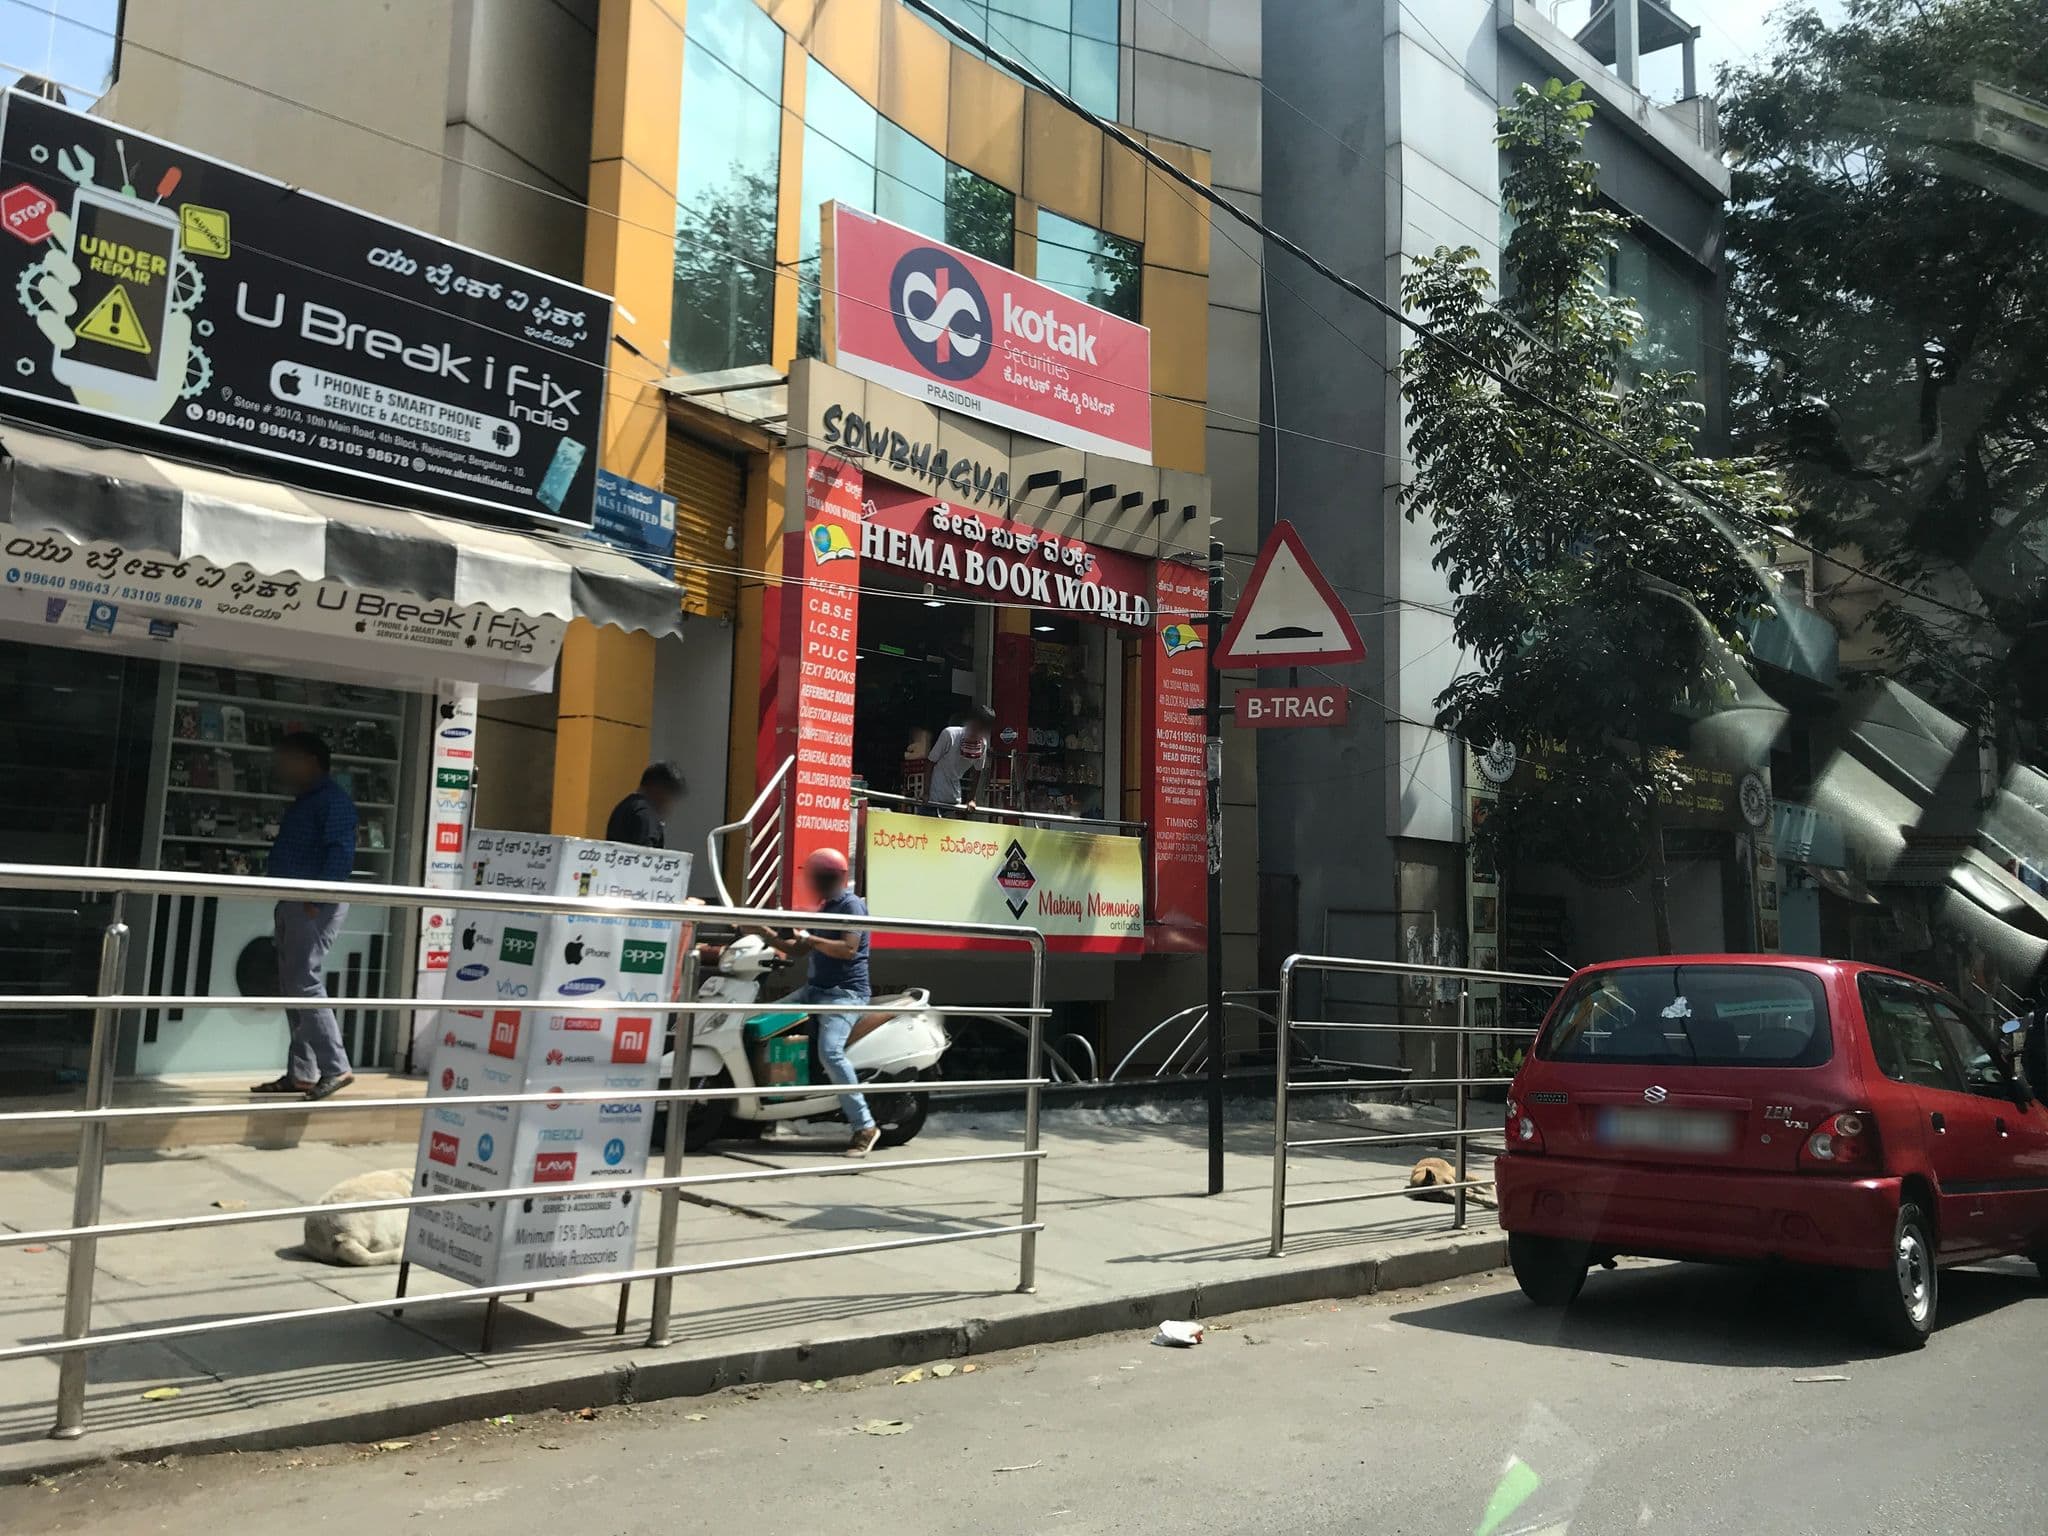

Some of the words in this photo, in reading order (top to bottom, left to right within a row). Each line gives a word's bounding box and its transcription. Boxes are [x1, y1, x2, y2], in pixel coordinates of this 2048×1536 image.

[9, 200, 47, 227] STOP
[79, 234, 167, 276] UNDER
[90, 257, 151, 285] REPAIR
[236, 281, 286, 328] U
[301, 301, 472, 384] Break
[484, 356, 495, 390] i
[1003, 293, 1098, 366] kotak
[1003, 340, 1070, 380] Securities
[234, 395, 262, 413] Store
[263, 404, 271, 413] #
[323, 375, 371, 400] PHONE
[375, 390, 385, 403] &
[388, 393, 435, 417] SMART
[439, 407, 482, 430] PHONE
[927, 384, 981, 412] PRASIDDHI
[324, 394, 375, 418] SERVICE
[379, 406, 388, 420] &
[391, 411, 472, 443] ACCESSORIES
[509, 400, 570, 431] India
[206, 409, 256, 431] 99640
[259, 421, 306, 443] 99643
[319, 436, 363, 456] 83105
[366, 447, 409, 467] 98678
[823, 404, 1009, 511] SOWBHAGYA
[427, 463, 534, 496] www.ubreakifixindia.com
[861, 521, 959, 582] HEMA
[965, 549, 1051, 605] BOOK
[1054, 574, 1152, 629] WORLD
[23, 571, 65, 588] 99640
[69, 577, 110, 595] 99643
[121, 586, 161, 603] 83105
[164, 594, 203, 609] 98678
[317, 587, 348, 610] U
[355, 593, 466, 630] Break
[473, 612, 482, 632] i
[809, 599, 853, 621] C.B.S.E
[809, 620, 851, 641] I.C.S.E
[808, 641, 849, 662] P.U.C
[801, 661, 824, 678] TEXT
[824, 666, 855, 685] BOOKS
[1172, 667, 1194, 677] ADDRESS
[800, 705, 832, 721] QUESTION
[832, 711, 853, 726] BANKS
[1247, 696, 1335, 719] B-TRAC
[799, 749, 829, 765] GENERAL
[829, 753, 852, 768] BOOKS
[1163, 752, 1179, 762] HEAD
[1180, 754, 1201, 764] OFFICE
[798, 770, 829, 787] CHILDREN
[829, 775, 852, 790] BOOKS
[797, 793, 813, 807] CD
[816, 795, 840, 810] ROM
[842, 798, 850, 811] &
[796, 815, 849, 833] STATIONARIES
[1165, 817, 1198, 829] TIMINGS
[432, 861, 463, 871] NOKIA
[1039, 889, 1082, 923] Making
[1087, 892, 1140, 918] Memories
[1110, 920, 1140, 931] artifacts
[585, 949, 611, 959] iPhone
[565, 981, 601, 992] SAMSUNG
[564, 1055, 595, 1063] HUAWEI
[456, 1077, 469, 1091] LG
[600, 1103, 642, 1114] NOKIA
[1764, 1106, 1793, 1120] ZEN
[537, 1160, 573, 1172] LAVA
[569, 1249, 618, 1267] Accessories
